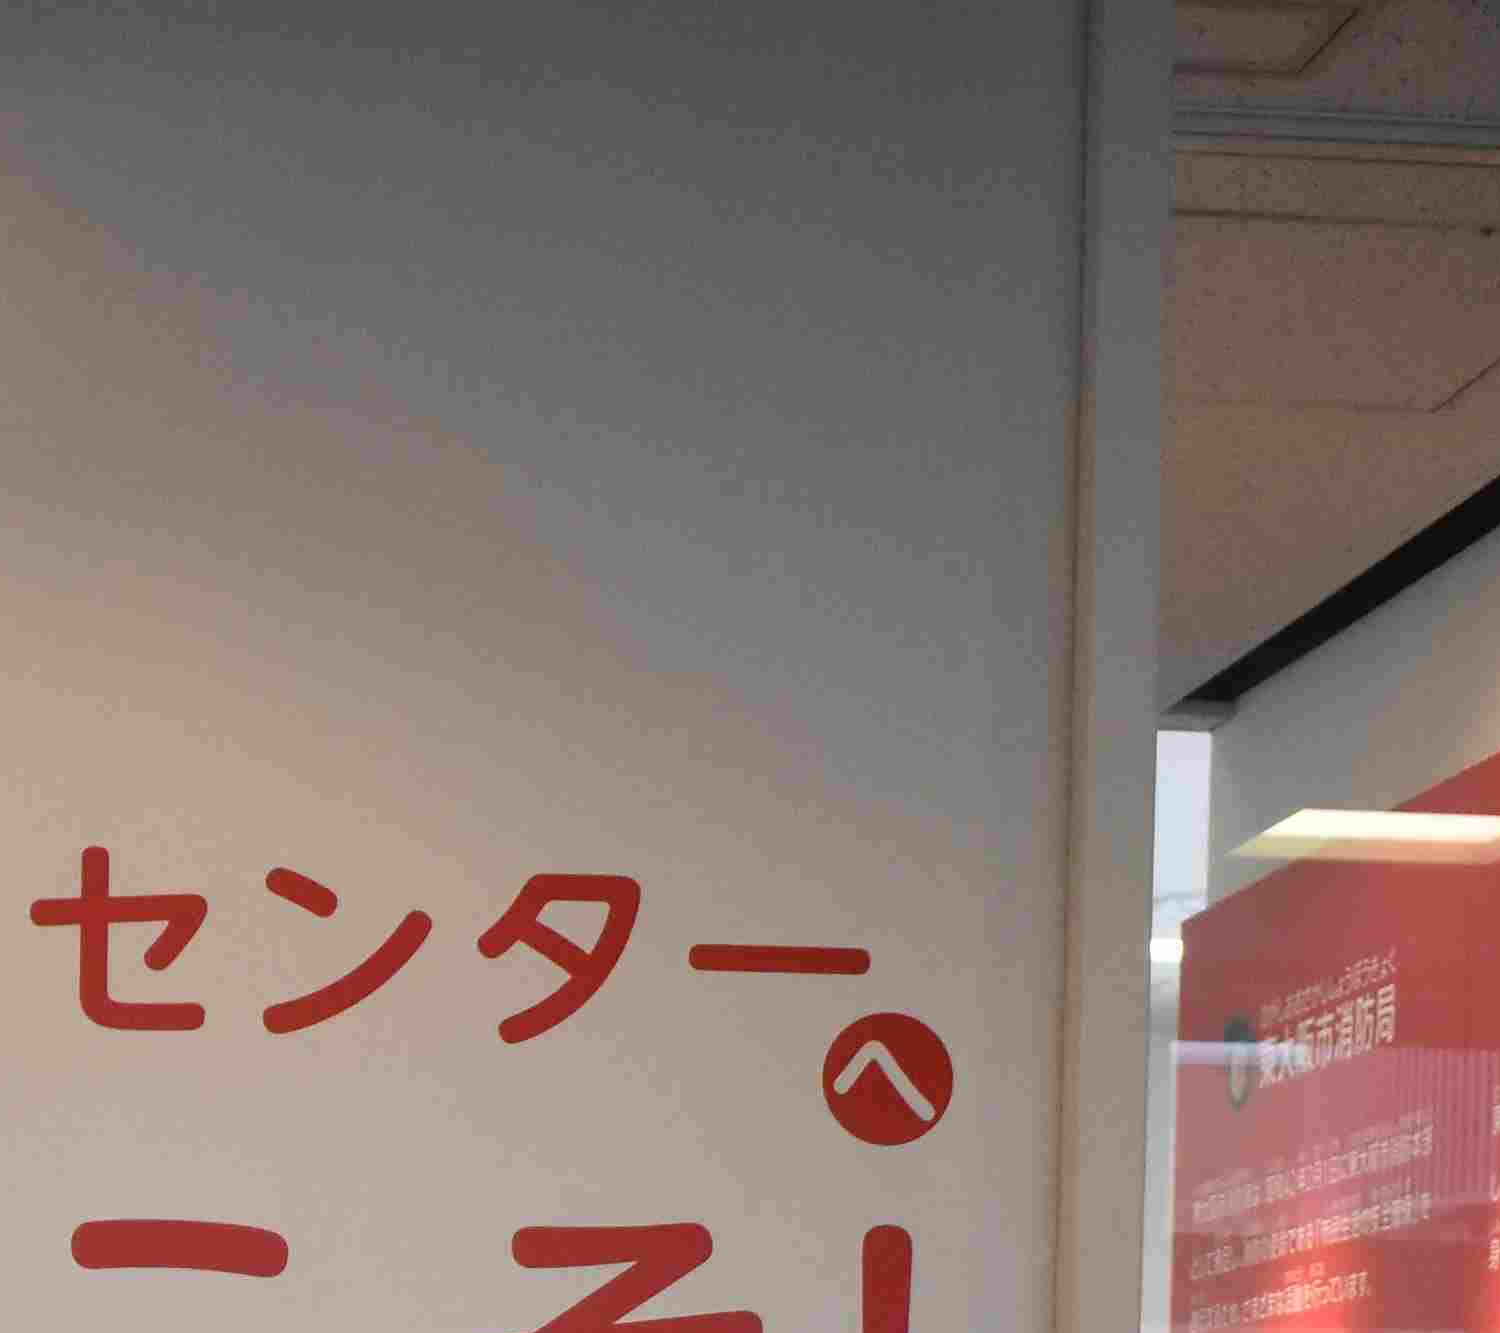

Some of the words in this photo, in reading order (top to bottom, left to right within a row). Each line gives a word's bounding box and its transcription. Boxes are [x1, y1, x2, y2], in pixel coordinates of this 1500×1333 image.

[30, 846, 872, 1046] センター
[831, 1039, 938, 1124] へ
[1257, 984, 1396, 1088] 東大阪市消防局
